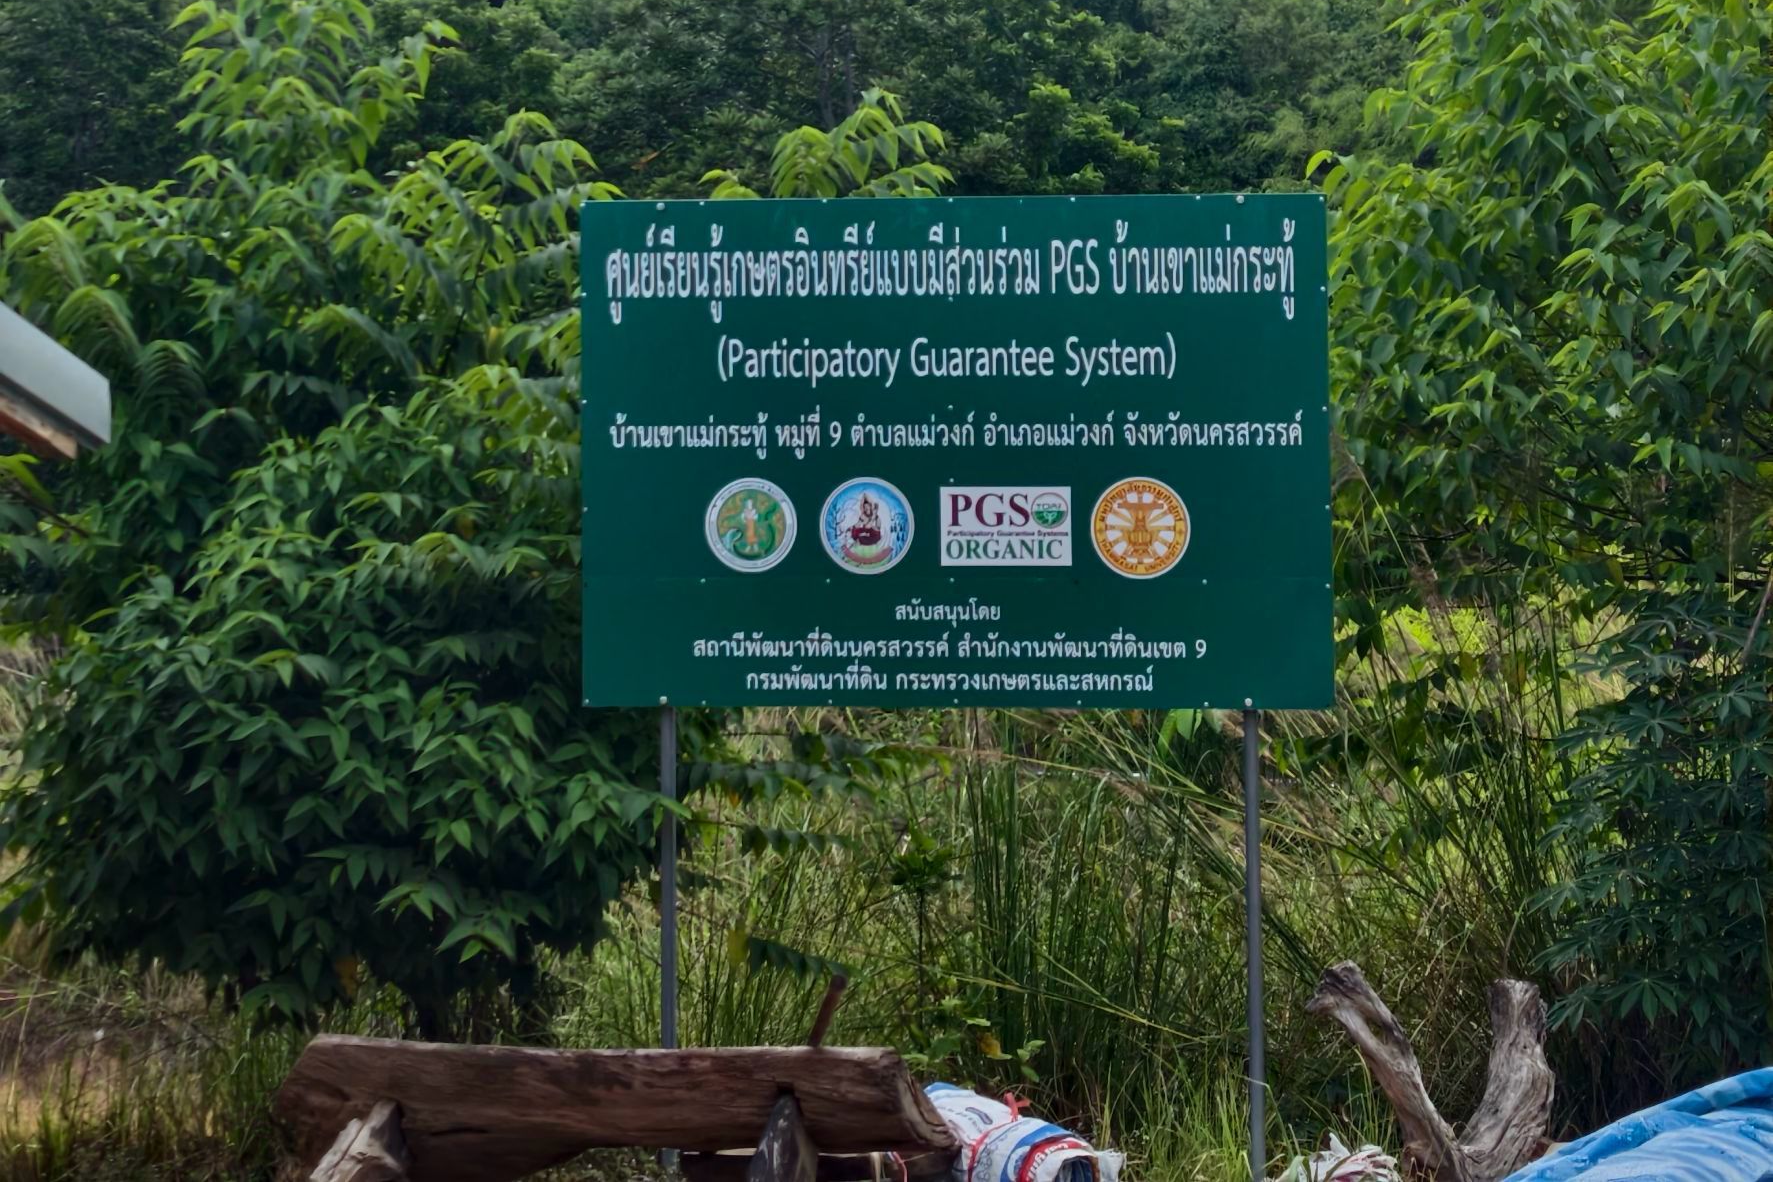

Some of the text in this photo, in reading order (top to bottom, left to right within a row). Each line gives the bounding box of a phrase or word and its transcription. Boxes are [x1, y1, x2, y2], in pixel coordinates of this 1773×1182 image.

[606, 217, 1296, 325] ศูนย์เรียนรู้เกษตรอินทรีย์แบบมีส่วนร่วม PGS บ้านเขาแม่กระทู้
[718, 331, 1177, 388] (Participatory Guarantee System)
[609, 404, 1303, 460] บ้านเขาแม่กระทู้ หมู่ที่ 9 ตำบลแม่วงก์ อำเภอแม่วงก์ จังหวัดนครสวรรค์
[947, 492, 1031, 528] PGS
[946, 538, 1063, 560] ORGANIC
[895, 597, 1001, 628] สนับสนุนโดย
[693, 626, 1207, 659] สถานีพัฒนาที่ดินนครสวรรค์ สำนักงานพัฒนาที่ดินเขต 9
[746, 659, 1154, 692] กรมพัฒนาที่ดิน กระทรวงเกษตรและสหกรณ์
